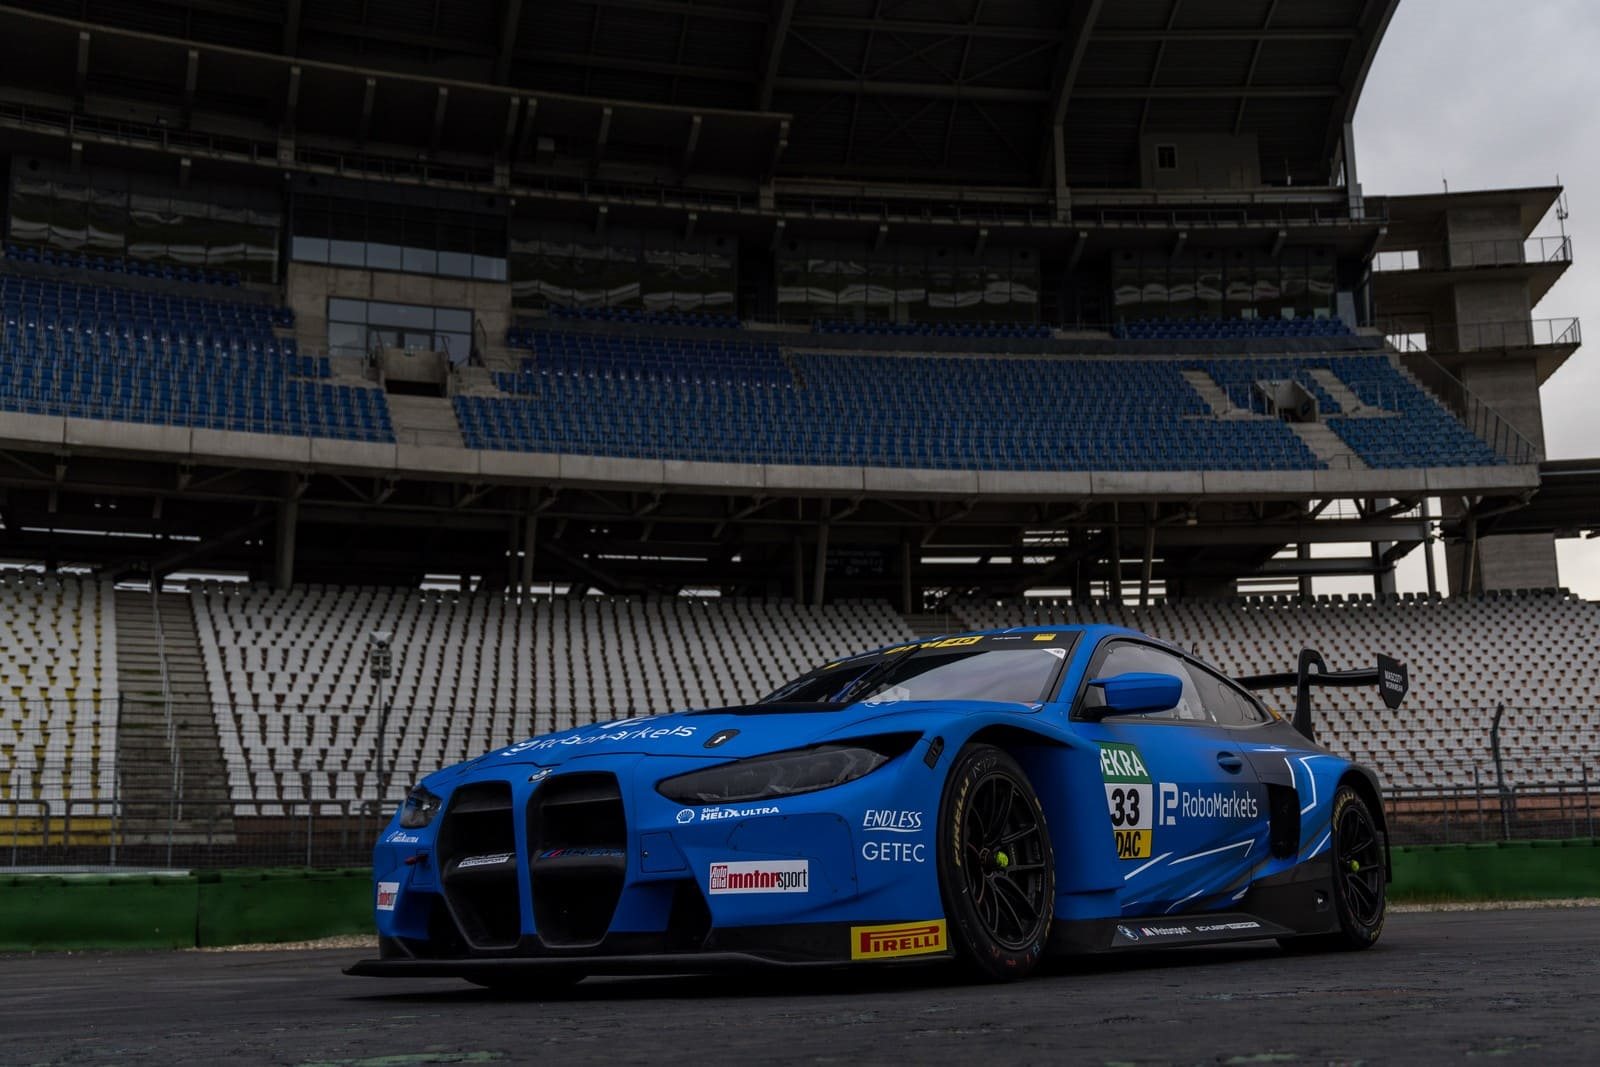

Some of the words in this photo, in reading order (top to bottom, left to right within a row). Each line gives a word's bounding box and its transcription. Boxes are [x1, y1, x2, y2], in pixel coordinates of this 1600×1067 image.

[700, 808, 740, 821] HELIX
[741, 806, 780, 816] ULTRA
[1111, 788, 1140, 827] 33
[1182, 789, 1258, 818] RoboMarkets
[863, 809, 922, 828] ENDLESS
[862, 841, 925, 863] GETEC
[860, 925, 941, 953] PIRELLI
